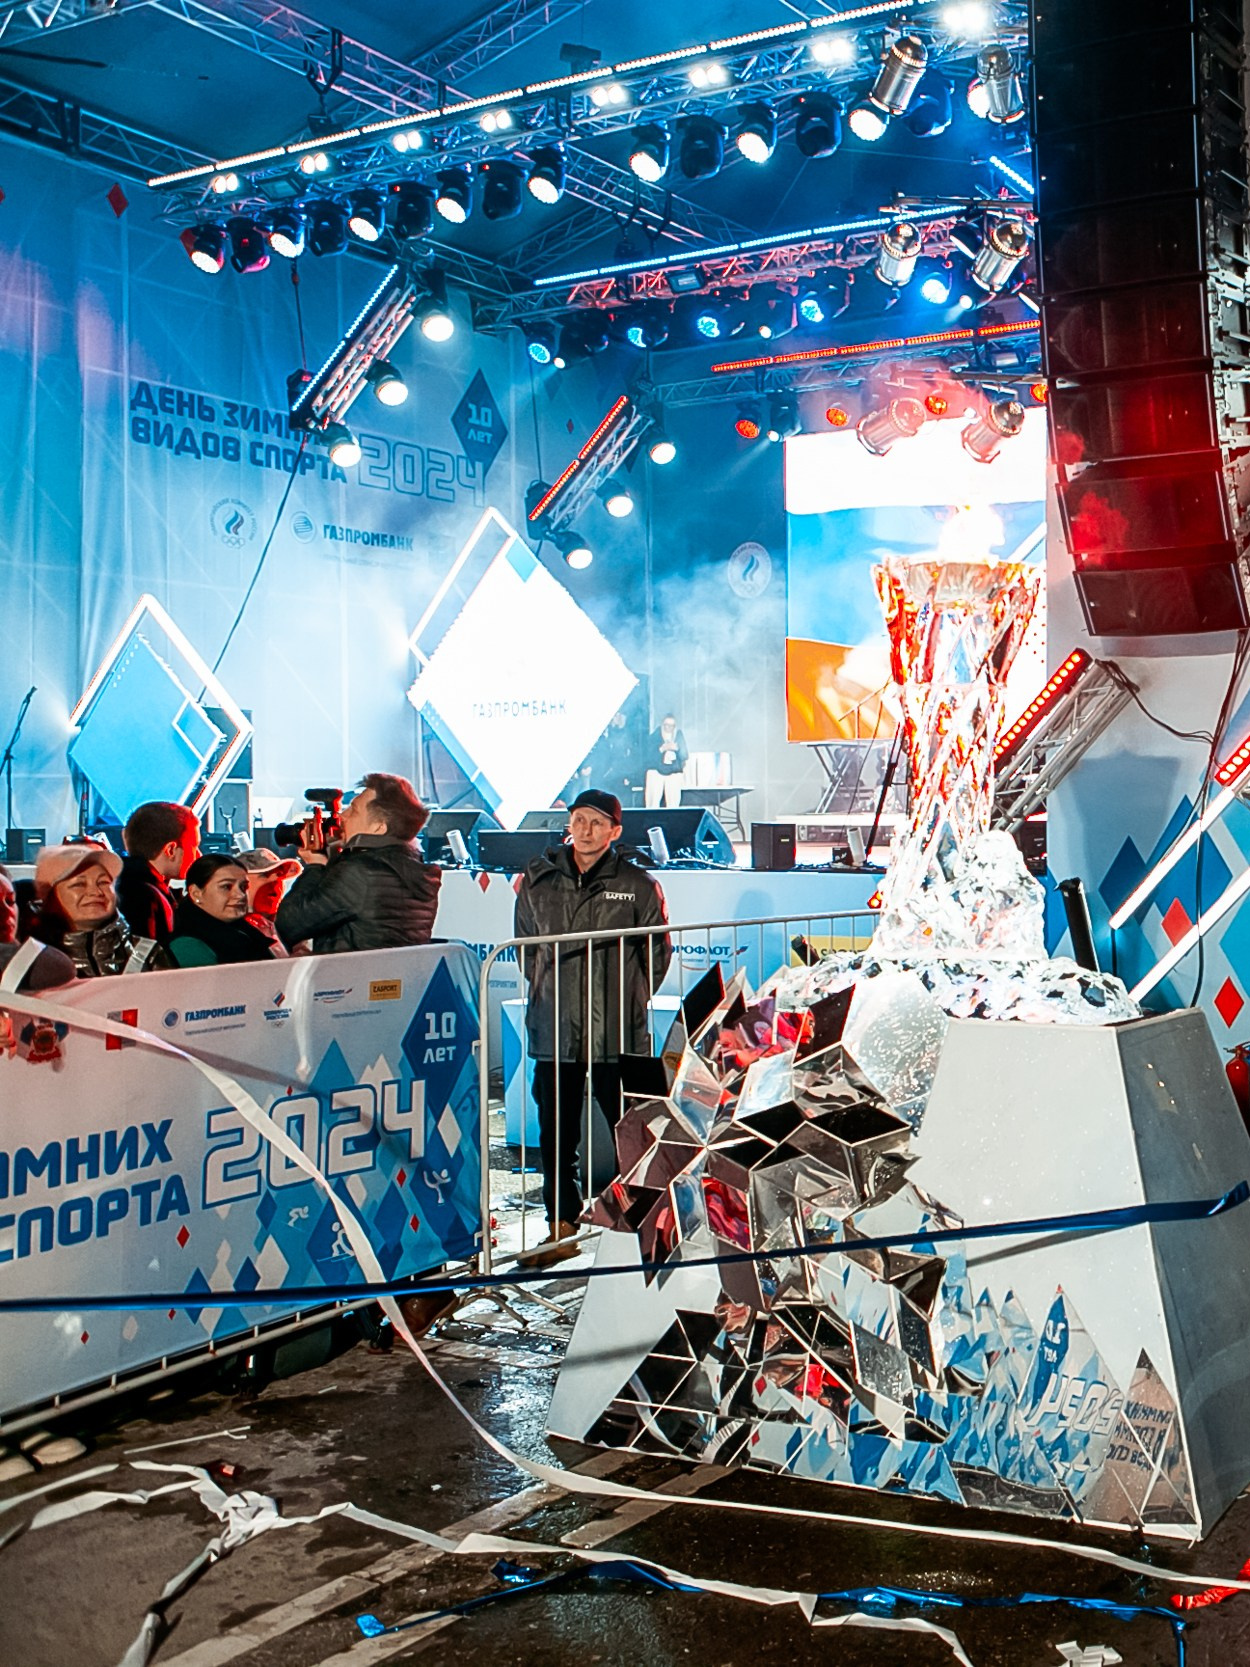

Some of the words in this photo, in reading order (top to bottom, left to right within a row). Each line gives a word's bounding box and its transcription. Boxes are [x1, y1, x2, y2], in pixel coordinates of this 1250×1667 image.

[130, 381, 216, 423] ДЕНЬ
[467, 403, 493, 428] 10
[131, 416, 241, 462] ВИДОВ
[250, 441, 347, 484] СПОРТА
[358, 433, 486, 508] 2024
[323, 524, 413, 551] ГАЗПРОМБАНК
[185, 1004, 246, 1022] ГАЗПРОМБАНК
[425, 1012, 456, 1040] 10
[202, 1079, 427, 1210] 2024
